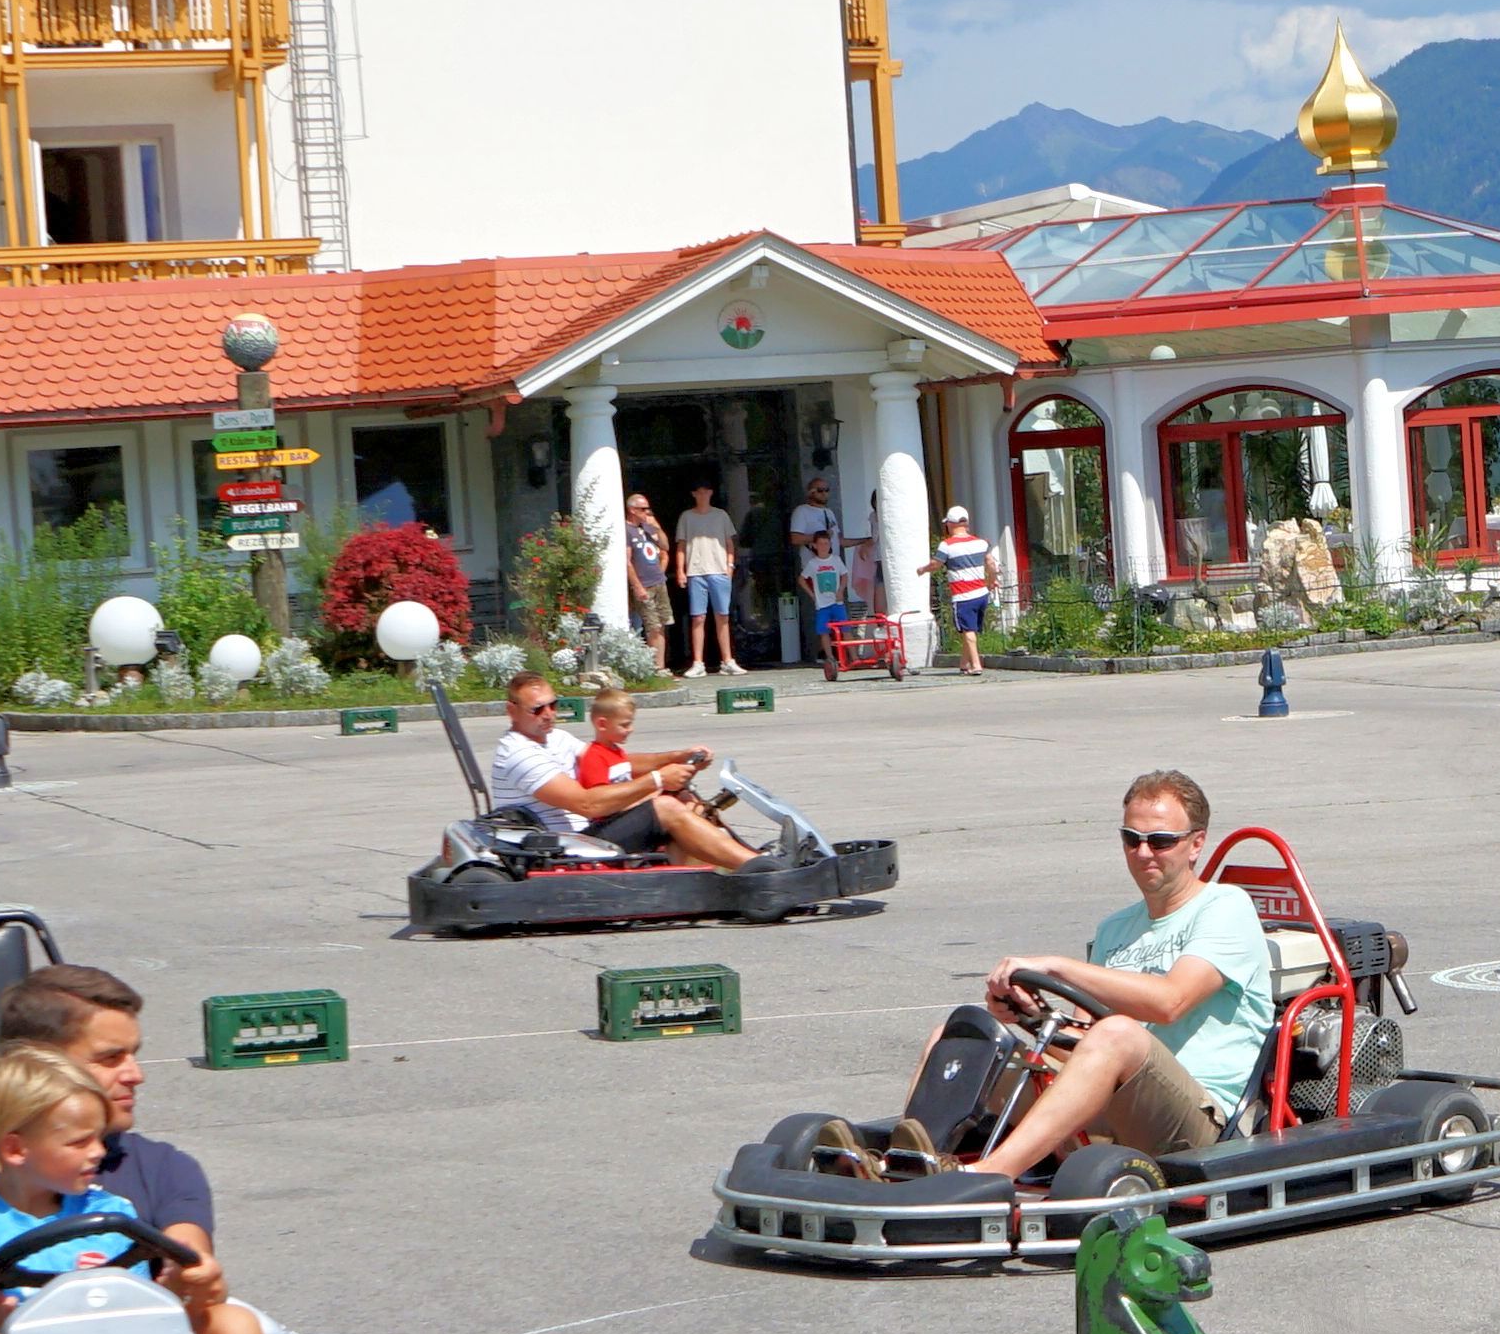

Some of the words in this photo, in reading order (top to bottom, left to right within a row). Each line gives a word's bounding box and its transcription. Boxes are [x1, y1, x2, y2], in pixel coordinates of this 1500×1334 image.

[220, 453, 285, 466] RESTAURANT
[289, 451, 309, 461] BAR
[233, 502, 298, 514] KEGELBAHN
[1131, 1158, 1167, 1188] DUNLO
